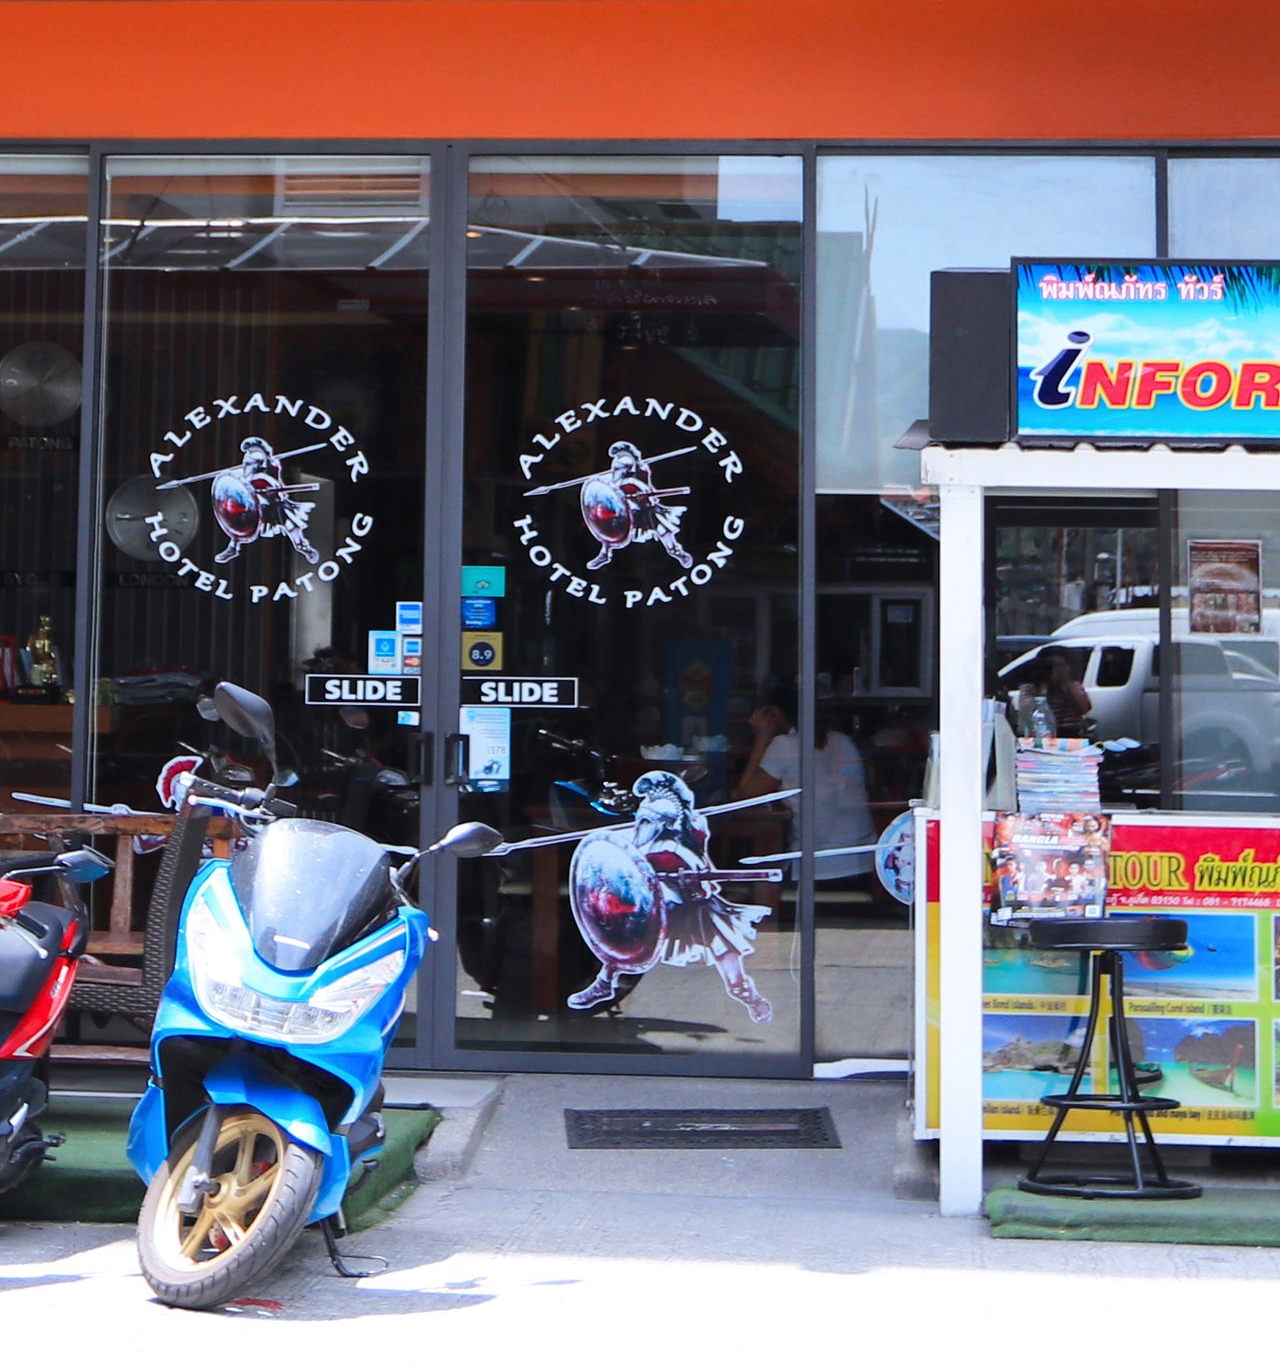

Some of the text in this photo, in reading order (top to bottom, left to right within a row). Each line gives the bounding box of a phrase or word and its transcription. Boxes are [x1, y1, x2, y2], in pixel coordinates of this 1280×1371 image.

[1177, 274, 1225, 300] ทัวร์
[148, 392, 370, 483] ALEXANDER
[519, 396, 744, 483] ALEXANDER
[144, 512, 374, 603] HOTEL PATONG
[513, 515, 745, 608] HOTEL PATONG
[471, 649, 493, 660] 8.9
[324, 679, 559, 703] SLIDE SLIDE
[1011, 834, 1059, 844] BANGLA
[1108, 853, 1186, 888] TOUR
